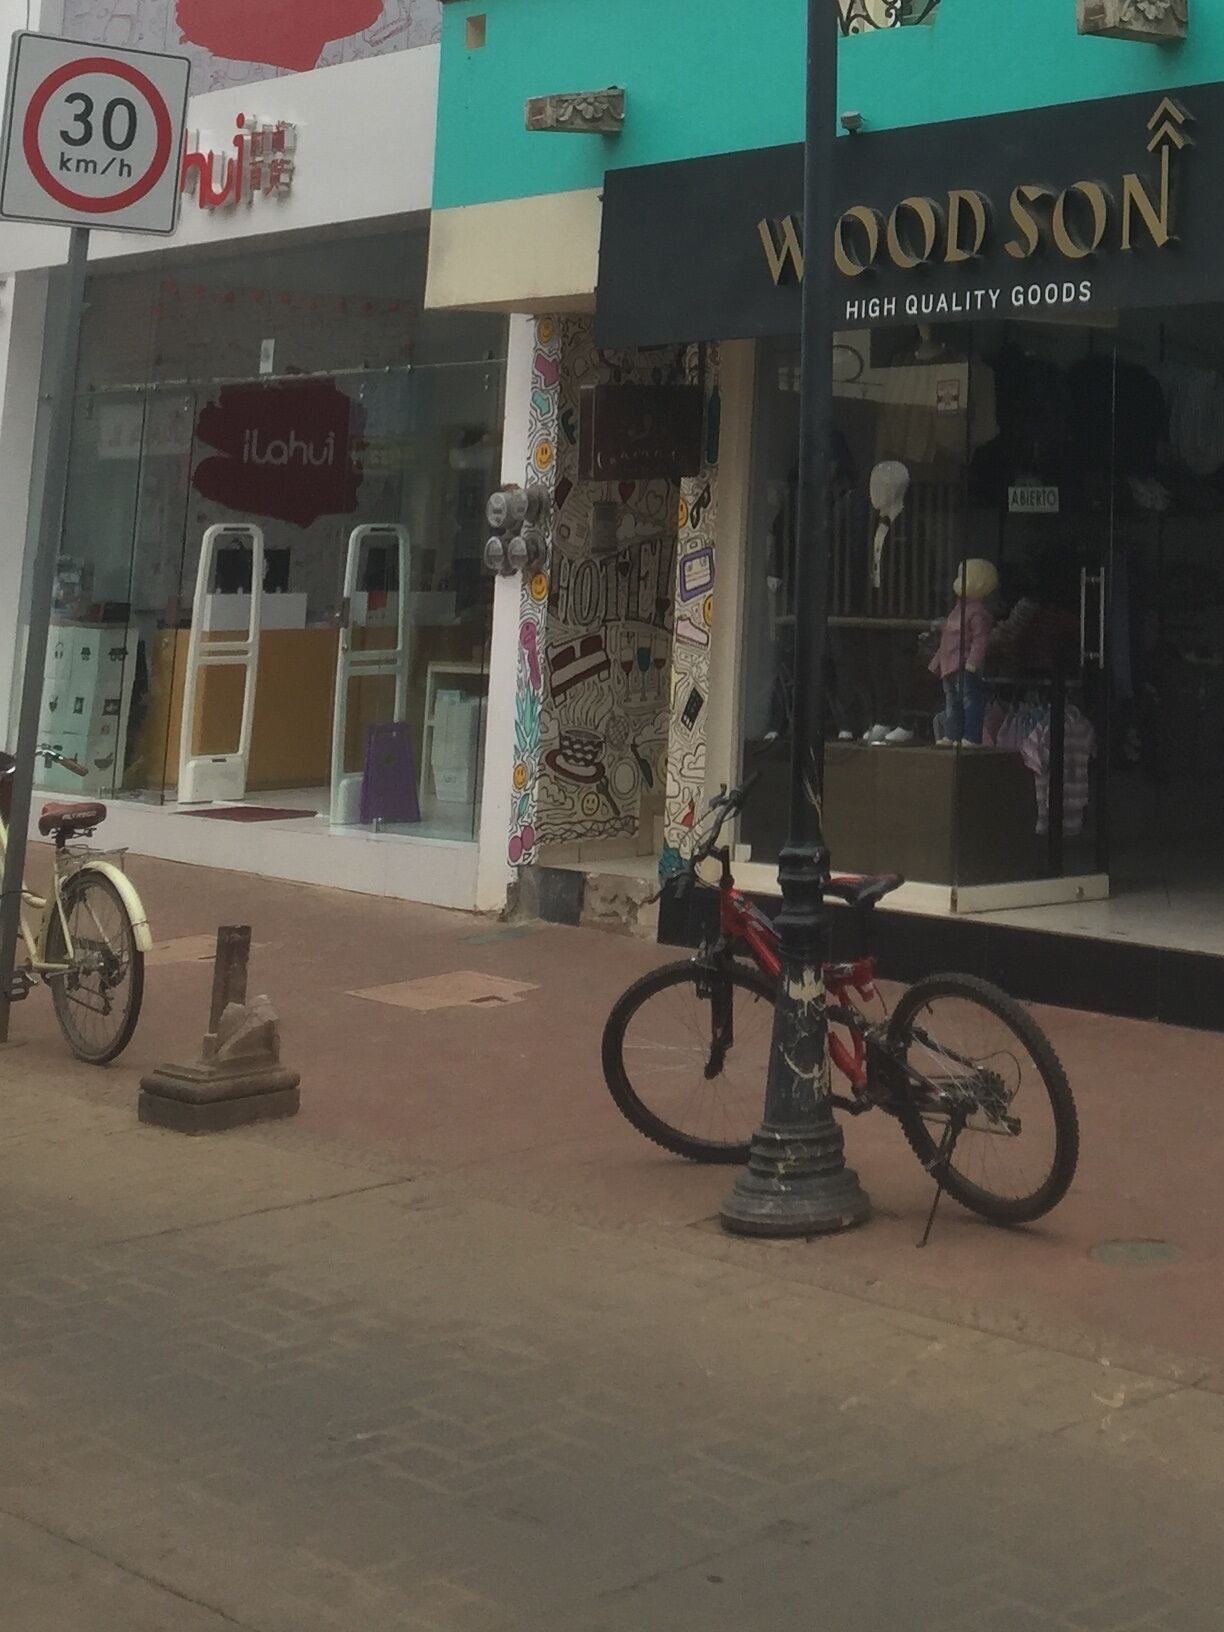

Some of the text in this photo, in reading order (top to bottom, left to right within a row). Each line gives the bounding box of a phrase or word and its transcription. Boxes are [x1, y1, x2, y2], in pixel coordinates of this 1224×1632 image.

[60, 92, 137, 151] 30
[59, 152, 132, 177] km/h
[757, 145, 1170, 286] WOOD SON
[846, 280, 1092, 320] HIGH QUALITY GOODS
[1012, 489, 1057, 506] ABIERTO
